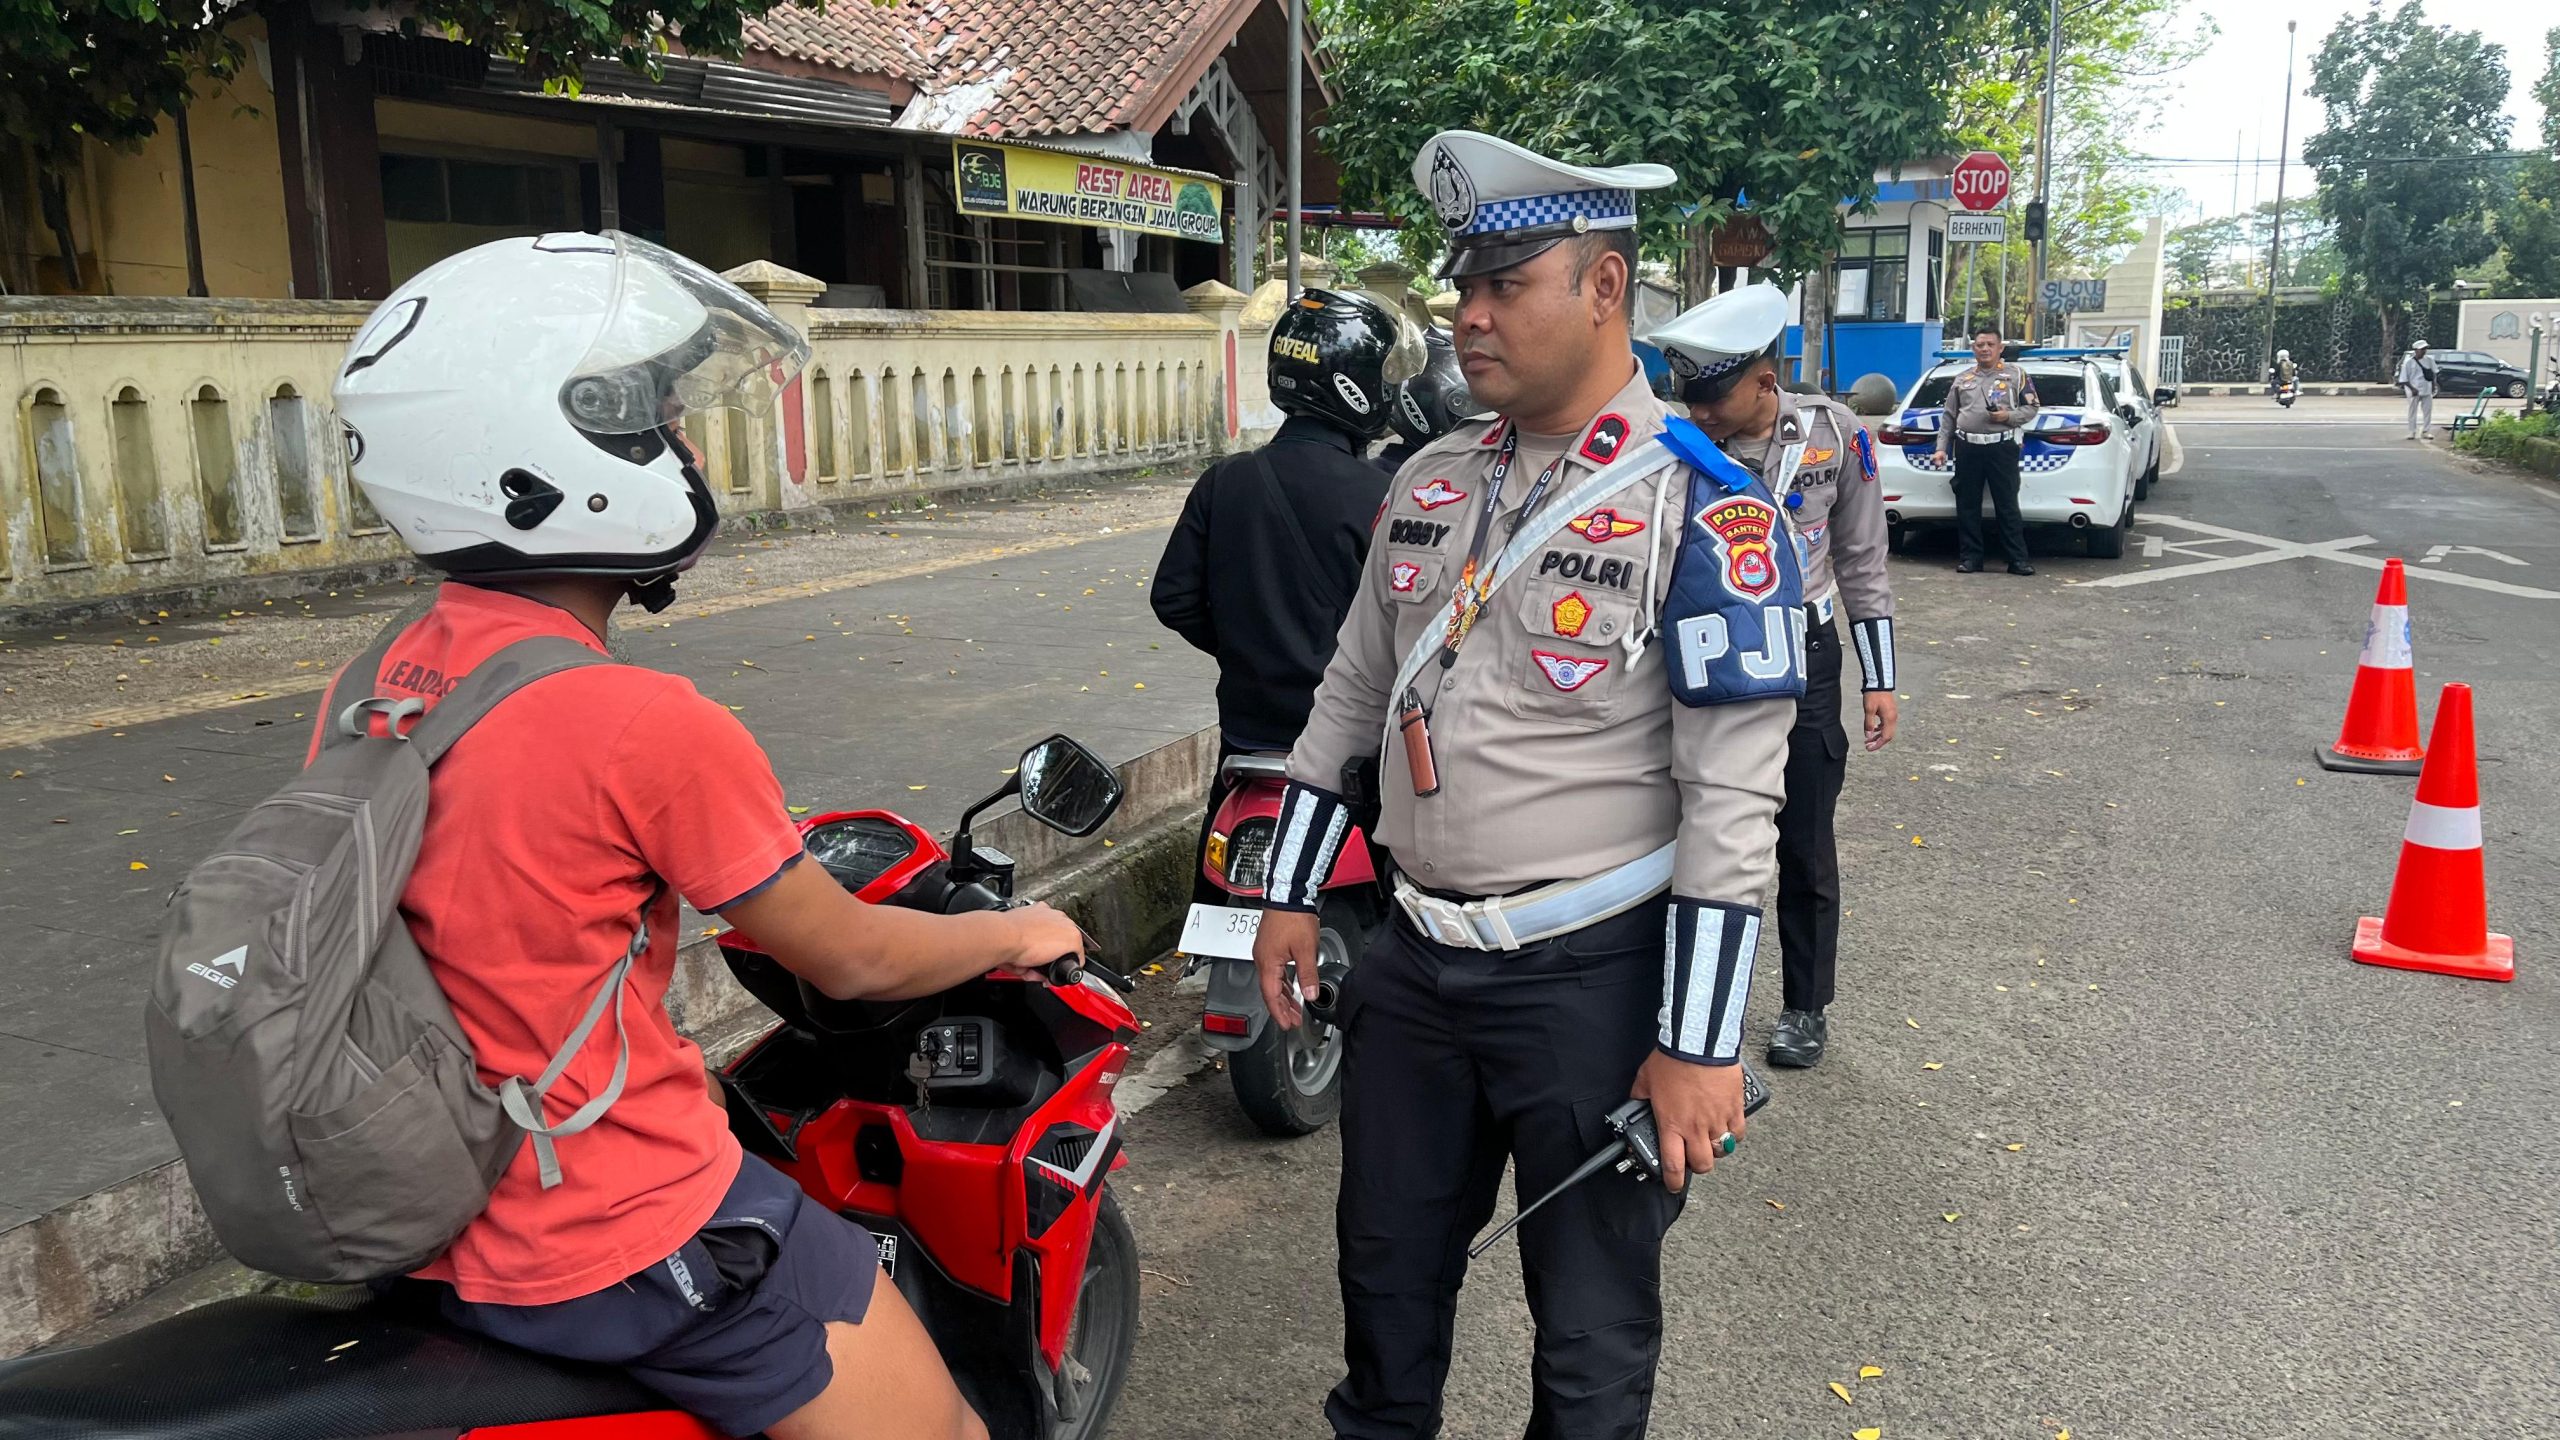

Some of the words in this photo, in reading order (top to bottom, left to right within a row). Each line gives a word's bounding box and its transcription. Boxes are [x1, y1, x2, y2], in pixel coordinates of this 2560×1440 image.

[1077, 163, 1125, 197] REST
[1126, 172, 1173, 206] AREA
[1957, 169, 2007, 194] STOP
[1017, 189, 1077, 217] WARUNG
[1080, 197, 1147, 224] BERINGIN
[1149, 208, 1178, 230] JAYA
[1180, 212, 1217, 235] GROUP
[1951, 221, 2001, 235] BERHENTI
[1273, 334, 1321, 365] GOZEAL
[1337, 377, 1368, 409] INK
[1402, 393, 1427, 427] INK
[1712, 505, 1769, 526] POLDA
[1725, 525, 1766, 539] BANTEN
[1539, 550, 1633, 590] POLRI
[1191, 909, 1200, 930] A
